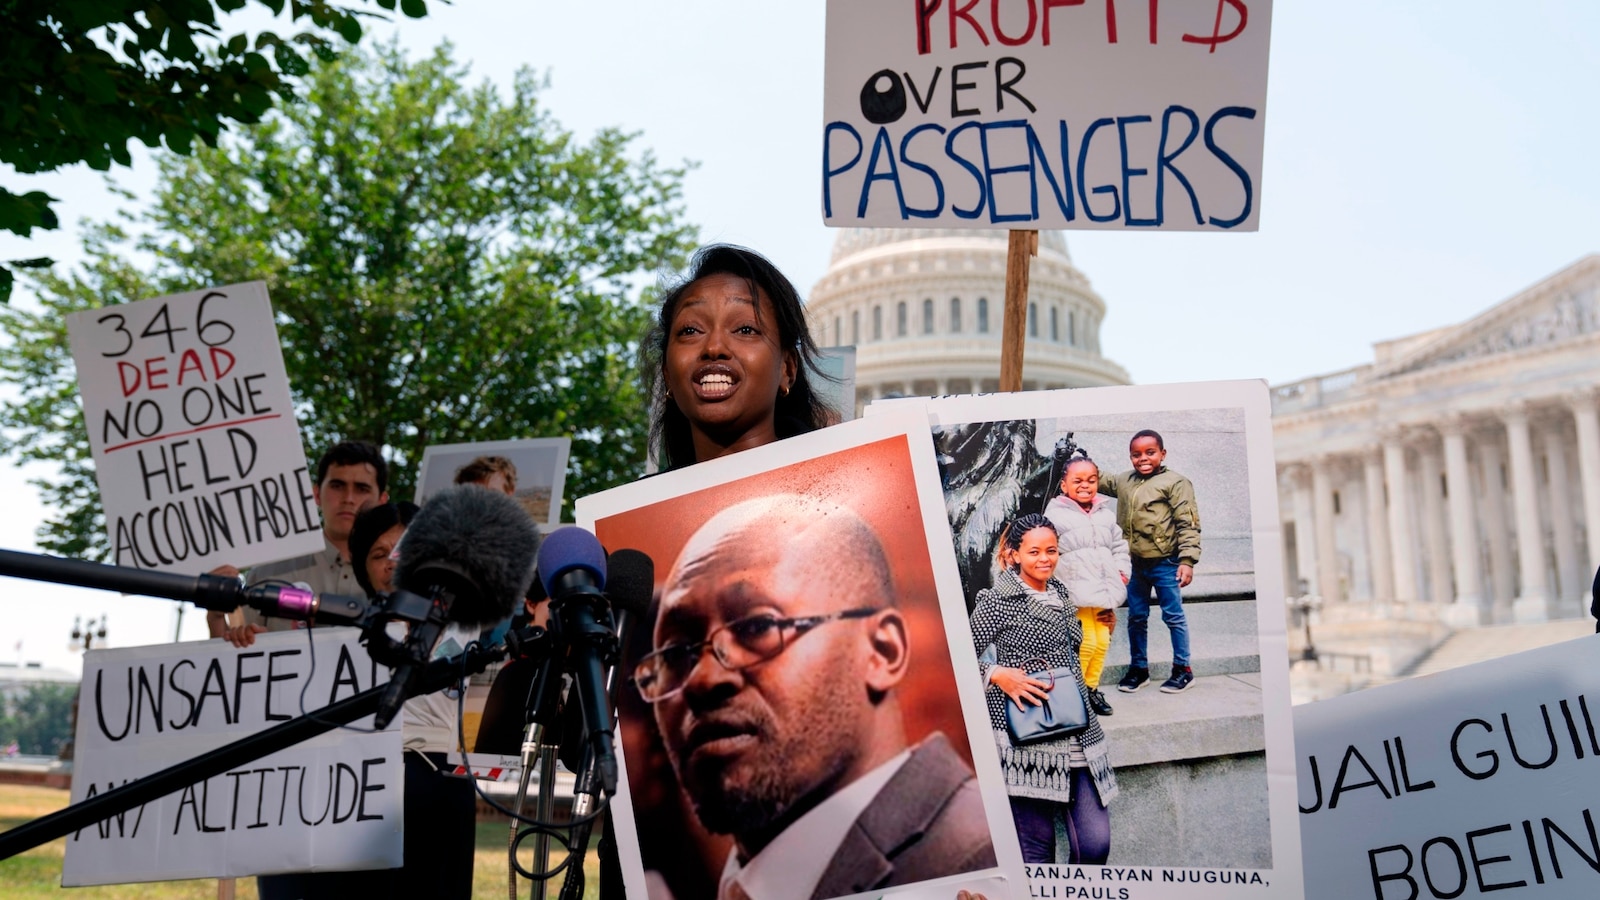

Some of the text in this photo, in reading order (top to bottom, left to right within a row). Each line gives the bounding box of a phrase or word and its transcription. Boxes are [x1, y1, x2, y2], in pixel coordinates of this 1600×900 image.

[860, 57, 1036, 124] OVER
[824, 105, 1256, 228] PASSENGERS
[97, 292, 235, 358] 346
[117, 347, 236, 397] DEAD
[103, 373, 272, 444] NO ONE
[137, 428, 258, 500] HELD
[115, 466, 321, 568] ACCOUNTABLE
[95, 650, 302, 741] UNSAFE
[173, 757, 386, 834] ALTITUDE
[1298, 736, 1436, 814] JAIL
[1101, 868, 1153, 882] RYAN
[1162, 869, 1270, 887] NJUGUNA,
[1367, 808, 1600, 900] BOEIN
[1065, 886, 1130, 900] PAULS
